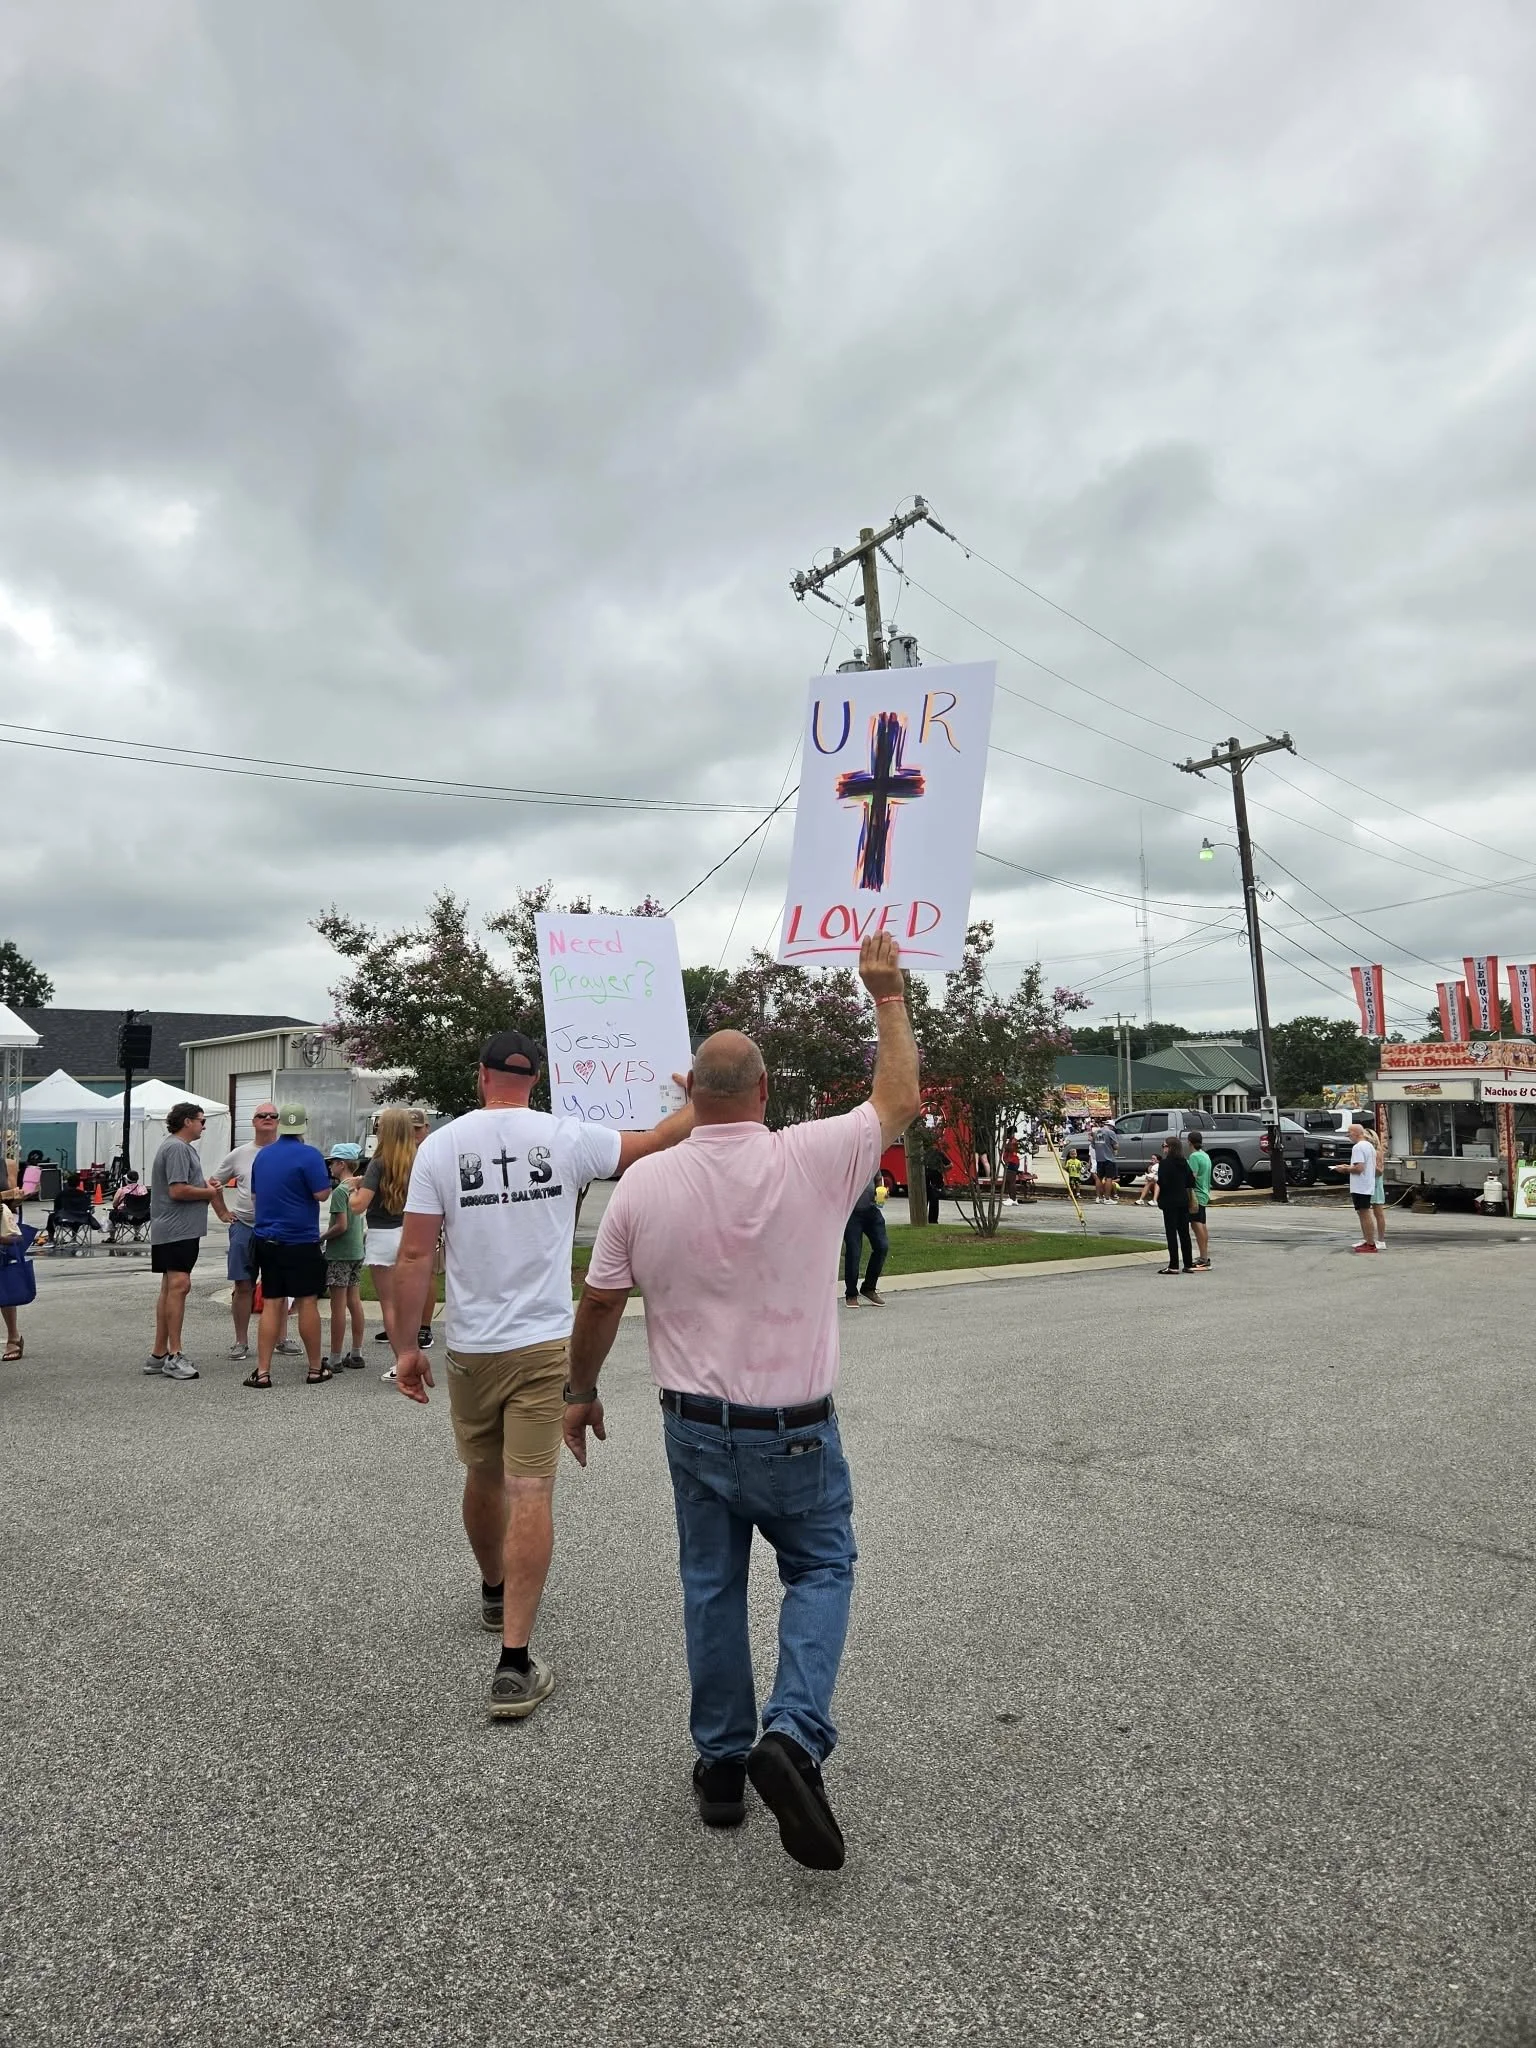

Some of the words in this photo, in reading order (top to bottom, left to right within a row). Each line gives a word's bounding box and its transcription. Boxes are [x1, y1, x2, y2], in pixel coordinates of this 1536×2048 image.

[812, 699, 855, 755] U
[919, 690, 961, 753] R
[786, 900, 942, 945] LOVED
[549, 929, 624, 958] Need
[549, 960, 655, 1004] Prayer?
[1363, 971, 1373, 997] NACHO
[1520, 969, 1528, 994] MINI
[1477, 962, 1489, 1030] LEMONADE
[1523, 996, 1532, 1034] DONUTS
[550, 1024, 636, 1052] Jesus
[1388, 1057, 1420, 1068] Mini
[1423, 1056, 1476, 1067] Donuts
[1484, 1086, 1518, 1097] Nachos
[1519, 1087, 1528, 1097] &
[460, 1193, 500, 1208] BROKEN
[501, 1192, 509, 1204] 2
[511, 1185, 563, 1203] SALVATION
